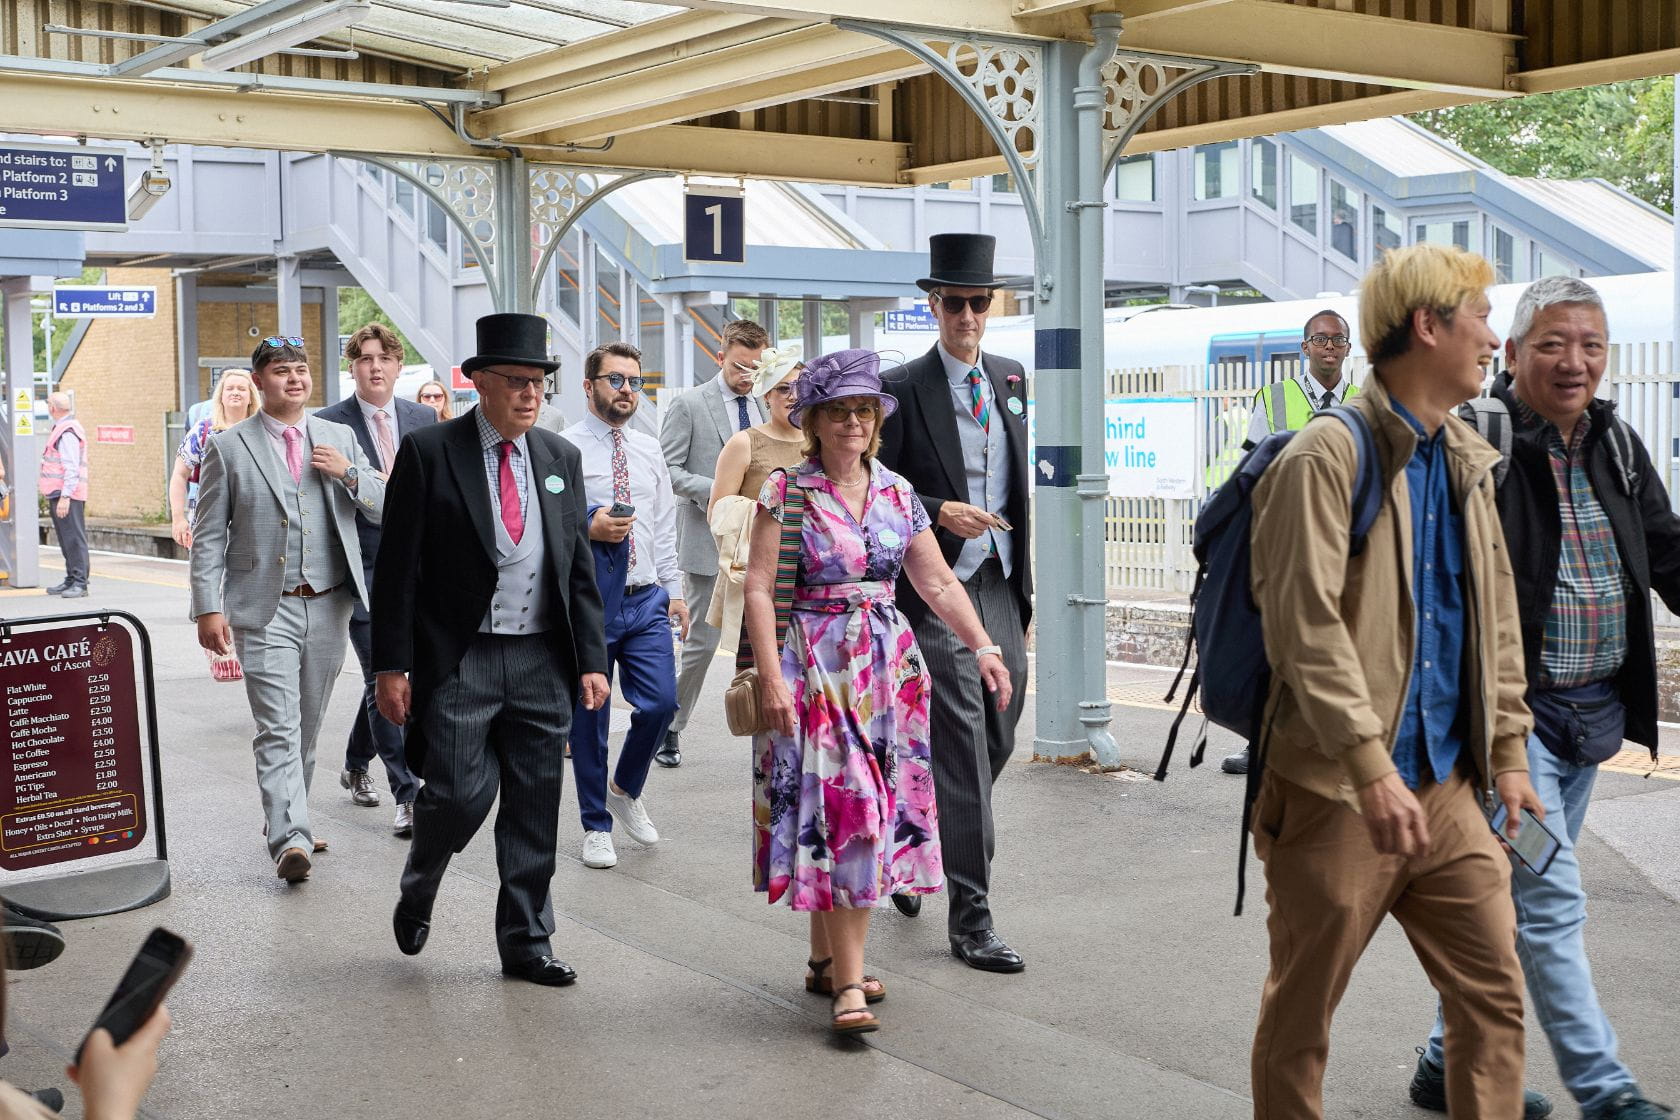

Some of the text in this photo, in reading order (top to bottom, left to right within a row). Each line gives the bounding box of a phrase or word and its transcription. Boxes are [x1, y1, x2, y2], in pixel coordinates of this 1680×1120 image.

[14, 154, 48, 166] stairs
[50, 157, 67, 167] to:
[3, 169, 68, 184] Platform 2
[4, 187, 68, 201] Platform 3
[705, 203, 722, 255] 1
[83, 302, 145, 312] Platforms 2 and 3
[108, 292, 121, 301] Lift
[1105, 417, 1146, 439] hind
[1124, 445, 1156, 468] line
[0, 637, 91, 668] AVA CAFÉ
[50, 660, 91, 672] of Ascot
[7, 674, 109, 695] Flat White £2.50
[7, 684, 110, 706] Cappuccino £2.50
[9, 695, 111, 717] Latte £2.50
[30, 713, 70, 725] Macchiato
[90, 705, 112, 716] £2.50
[31, 725, 57, 736] Mocha
[91, 716, 113, 726] £4.00
[11, 727, 114, 750] Hot Chocolate £3.50
[12, 738, 115, 761] Ice Coffee £4.00
[13, 748, 115, 772] Espresso £2.50
[14, 759, 116, 782] Americano £2.50
[15, 769, 117, 793] PG Tips £1.80
[16, 792, 43, 804] Herbal
[43, 791, 58, 799] Tea
[96, 780, 118, 791] £2.00
[5, 827, 28, 837] Honey
[54, 817, 74, 828] Decaf
[82, 815, 97, 823] Non
[98, 811, 117, 820] Dairy
[117, 808, 134, 817] Milk
[15, 815, 37, 824] Extras
[36, 824, 105, 841] Extra Shot Syrups
